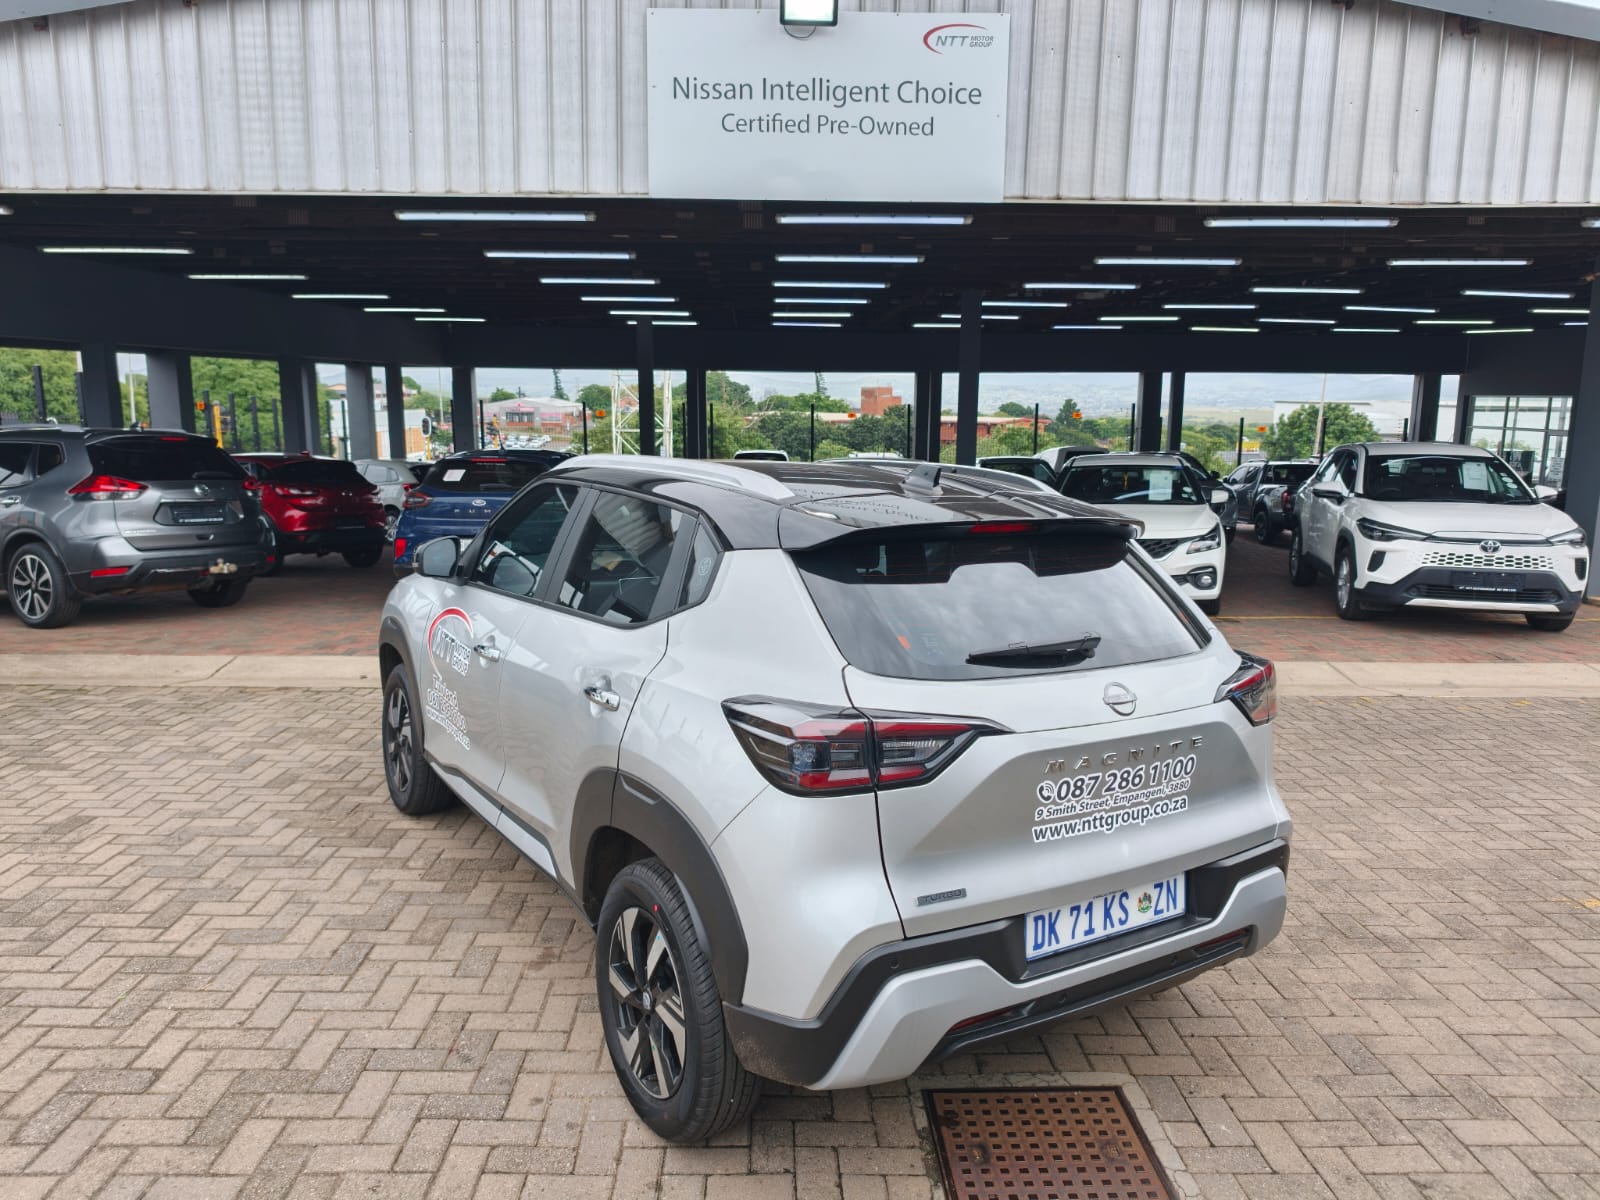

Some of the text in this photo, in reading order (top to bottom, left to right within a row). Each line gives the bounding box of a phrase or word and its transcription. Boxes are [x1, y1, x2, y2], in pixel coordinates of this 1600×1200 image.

[935, 35, 969, 47] NTT
[672, 76, 982, 107] Nissan Intelligent Choice
[721, 113, 934, 137] Certified Pre-Owned
[1045, 735, 1204, 774] MAGNITE
[1056, 755, 1196, 802] 087 286 1100
[1036, 779, 1190, 819] 9 Smith Street, Empangeni, 3880
[1033, 797, 1187, 841] www.nttgroup.co.za
[923, 888, 963, 902] TURBO
[1033, 878, 1178, 951] DK 71 KS ZN
